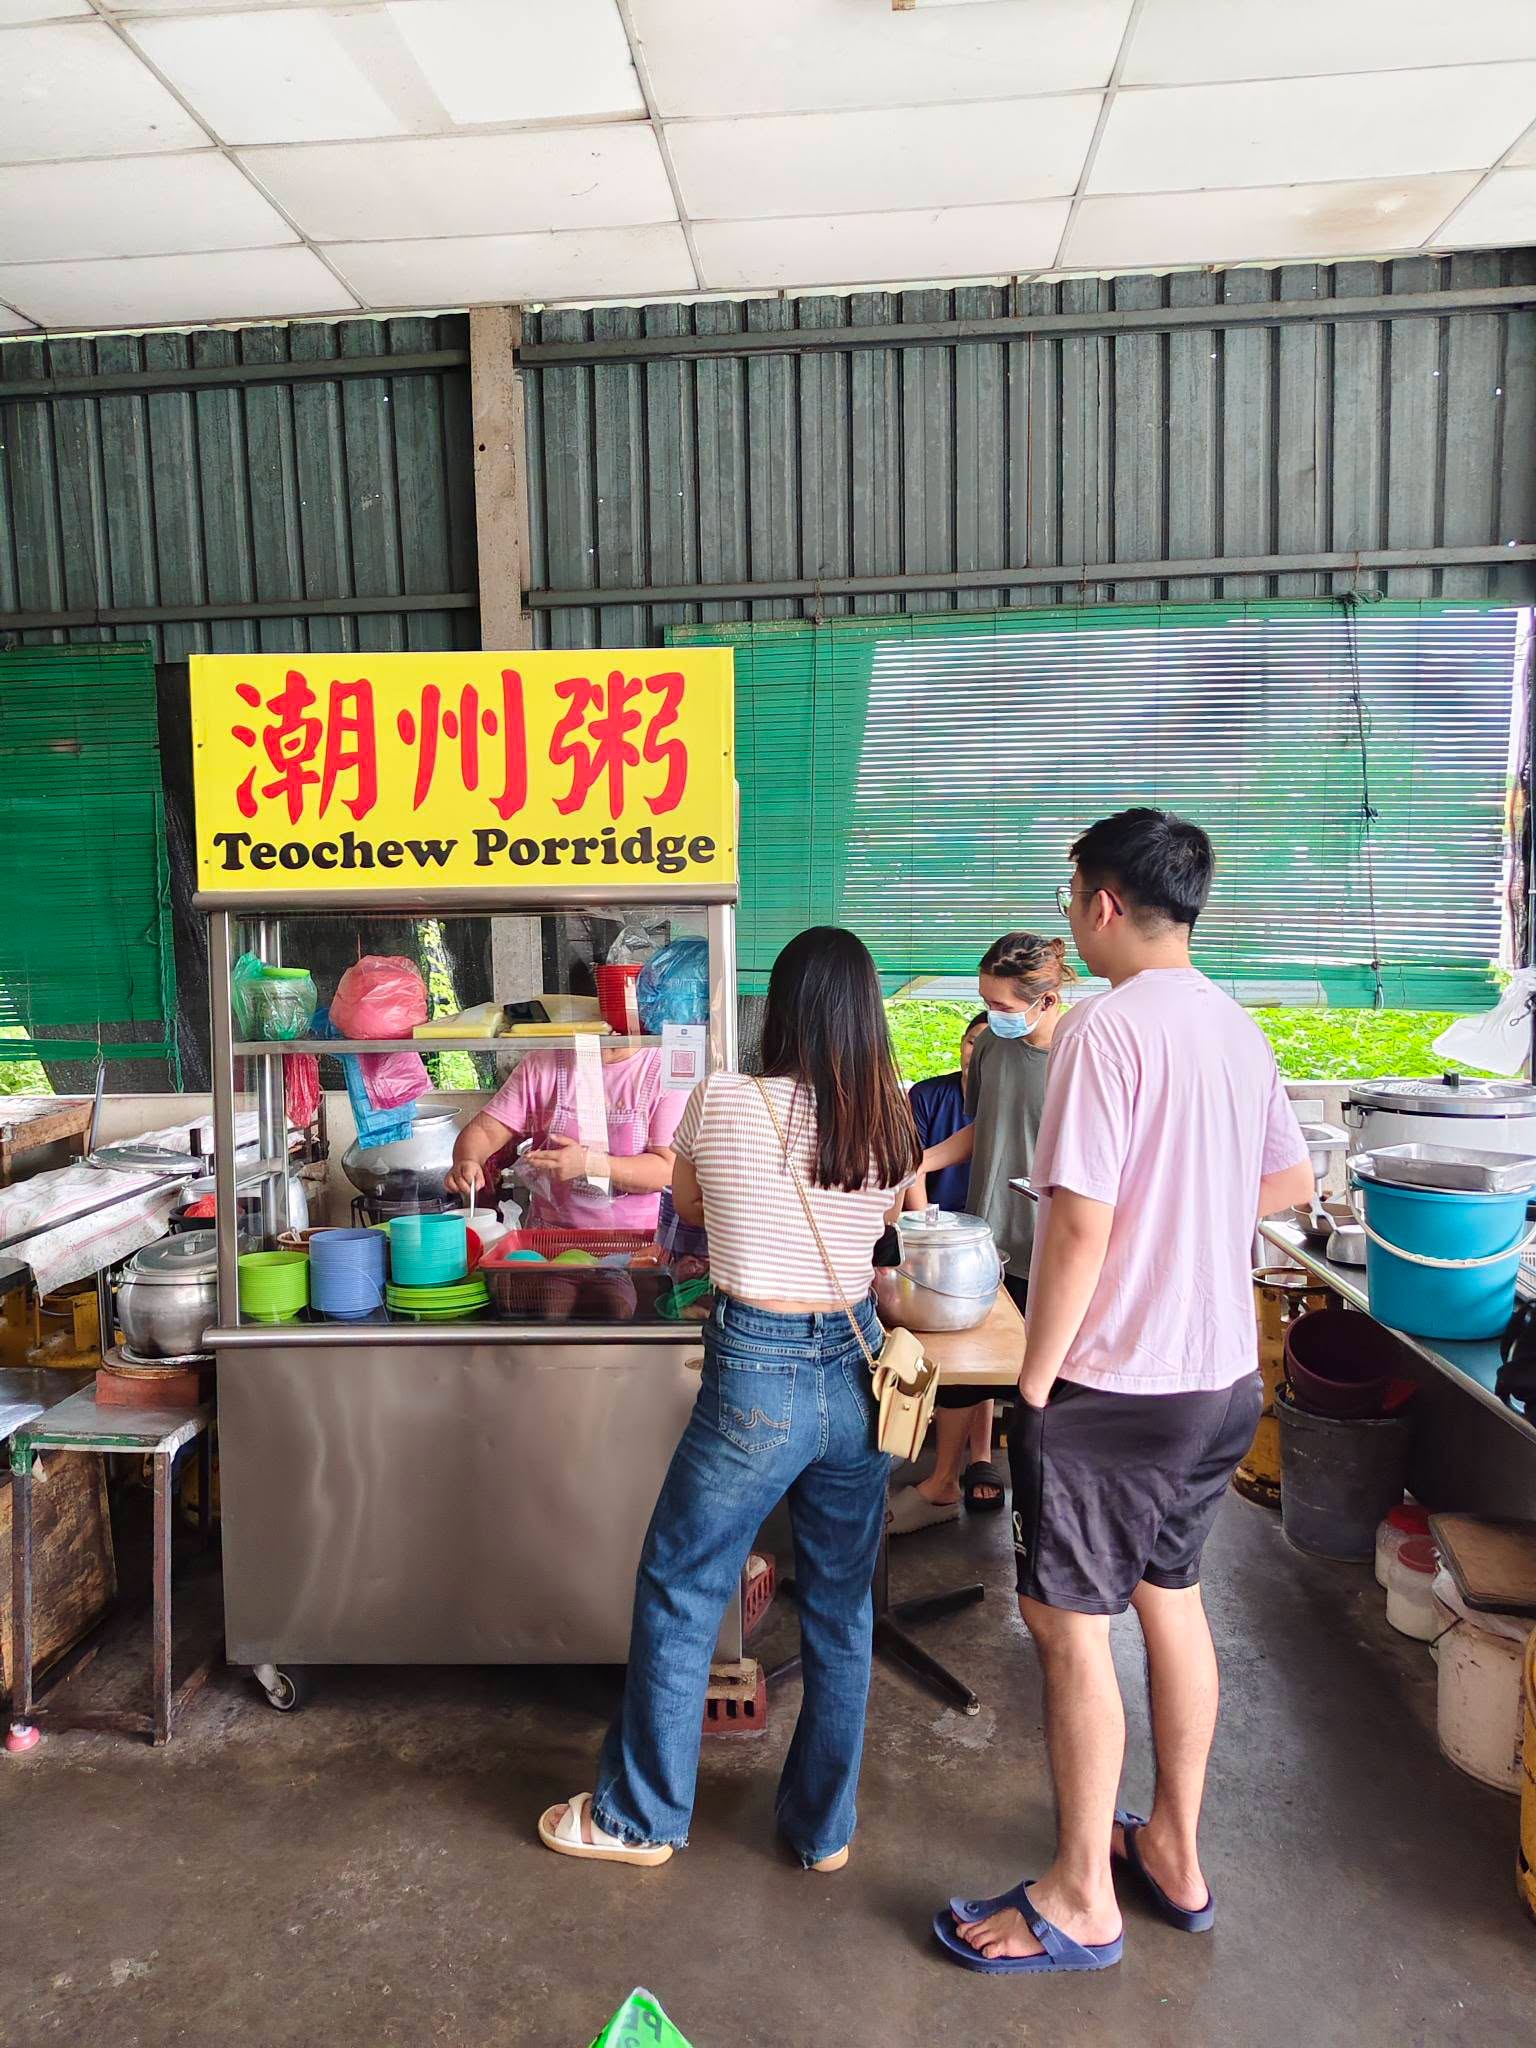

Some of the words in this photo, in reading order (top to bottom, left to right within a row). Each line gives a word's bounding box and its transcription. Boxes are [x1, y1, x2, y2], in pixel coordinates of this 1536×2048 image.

[232, 669, 688, 824] 潮州粥
[214, 831, 457, 870] Teochew
[474, 827, 716, 873] Porridge
